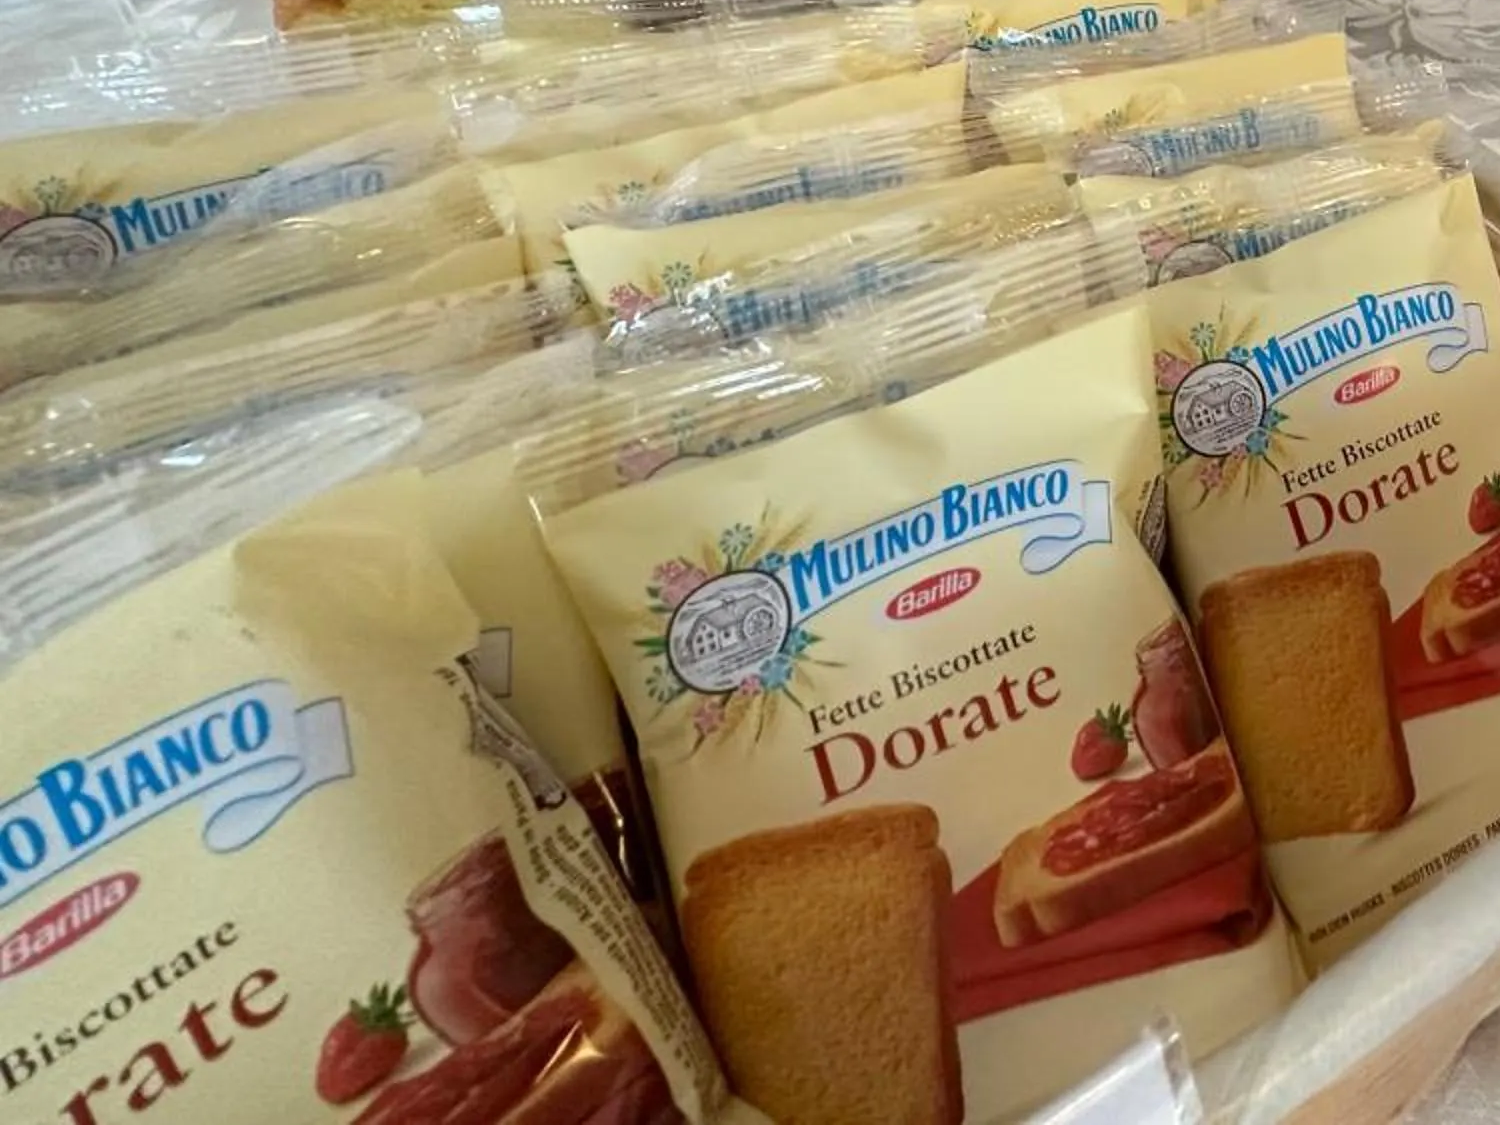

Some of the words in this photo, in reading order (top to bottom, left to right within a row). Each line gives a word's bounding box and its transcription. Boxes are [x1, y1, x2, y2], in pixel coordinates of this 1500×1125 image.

[1080, 6, 1158, 43] BIANCO
[1249, 321, 1362, 397] MULINO
[1357, 290, 1455, 346] BIANCO
[1340, 366, 1397, 404] Barilla
[1281, 458, 1337, 495] Fette
[1340, 408, 1442, 468] Biscottate
[1281, 442, 1462, 552] Dorate
[786, 512, 936, 612] MULINO
[941, 468, 1070, 541] BIANCO
[896, 570, 974, 616] Barilla
[808, 683, 885, 735] Fette
[890, 622, 1039, 701] Biscottate
[37, 699, 269, 850] BIANCO
[803, 664, 1063, 806] Dorate
[1, 877, 128, 975] Barilla
[0, 920, 240, 1094] Biscottate
